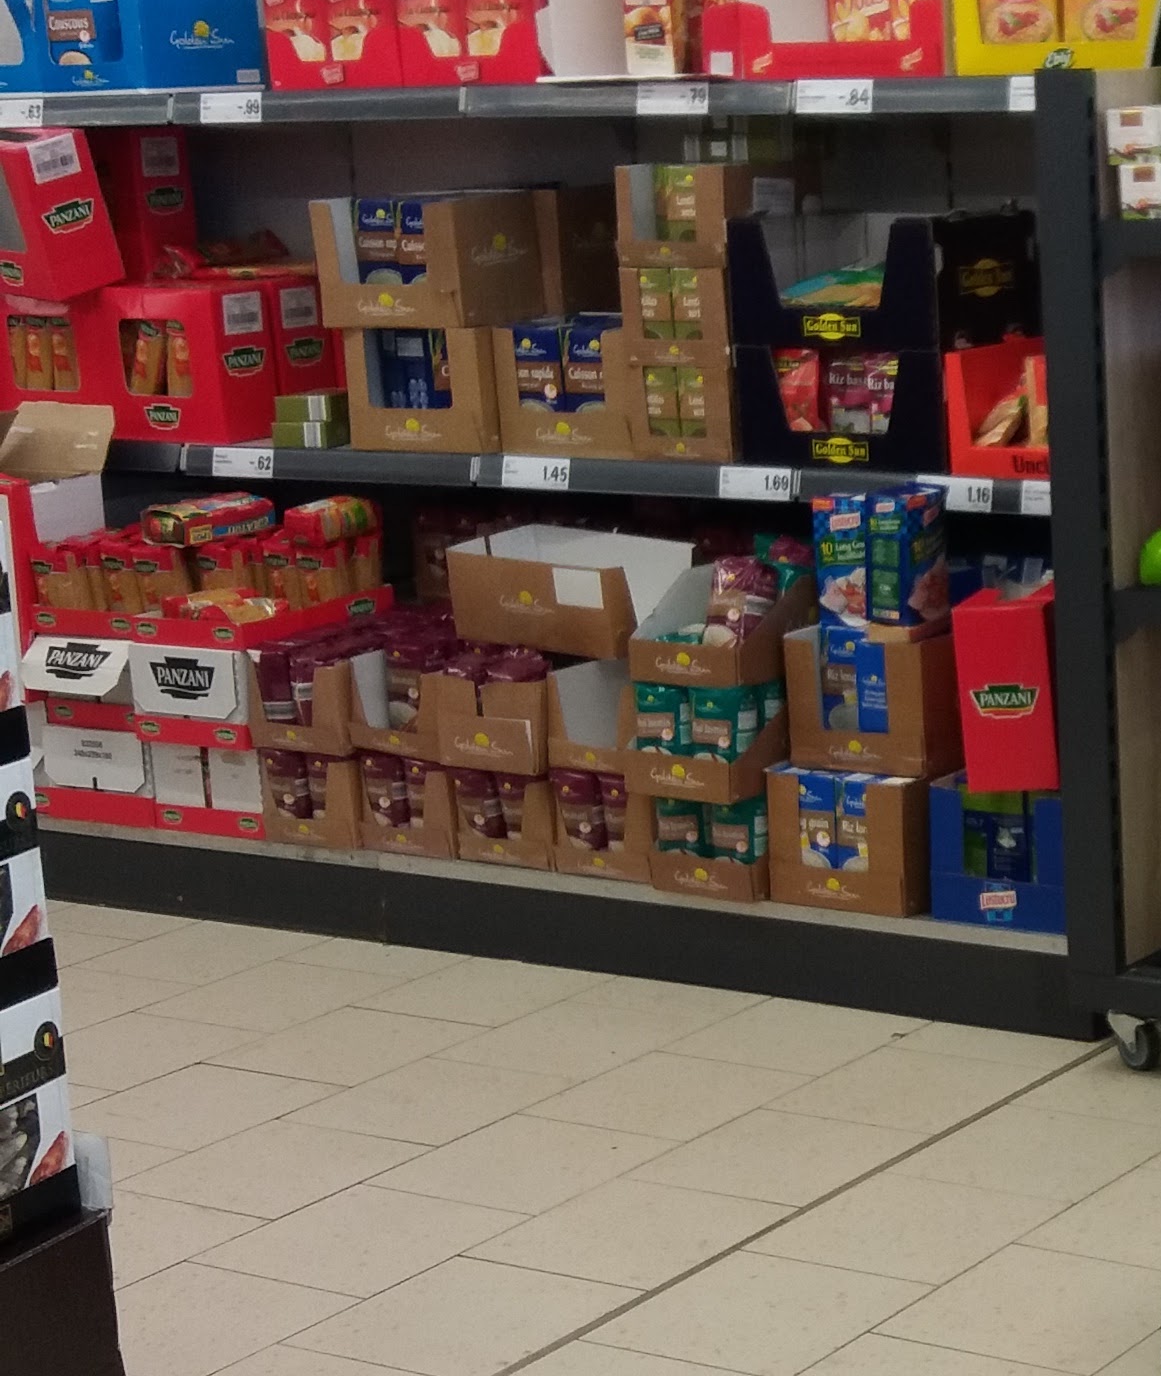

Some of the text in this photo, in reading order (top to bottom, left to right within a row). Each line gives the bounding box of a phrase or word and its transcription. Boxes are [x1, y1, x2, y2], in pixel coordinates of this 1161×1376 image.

[838, 88, 870, 106] -.84
[237, 99, 260, 115] -.99
[50, 205, 91, 227] PANZANI
[806, 319, 858, 332] Golden Sun
[228, 354, 262, 369] PANZANI
[828, 373, 845, 385] Riz
[868, 375, 882, 390] Riz
[815, 442, 867, 458] Golden Sun
[541, 465, 568, 482] 1.45
[763, 474, 789, 491] 1.69
[967, 486, 990, 504] 1.16
[47, 650, 102, 668] PANZANI
[156, 666, 210, 688] PANZANI
[979, 691, 1031, 708] PANZANI
